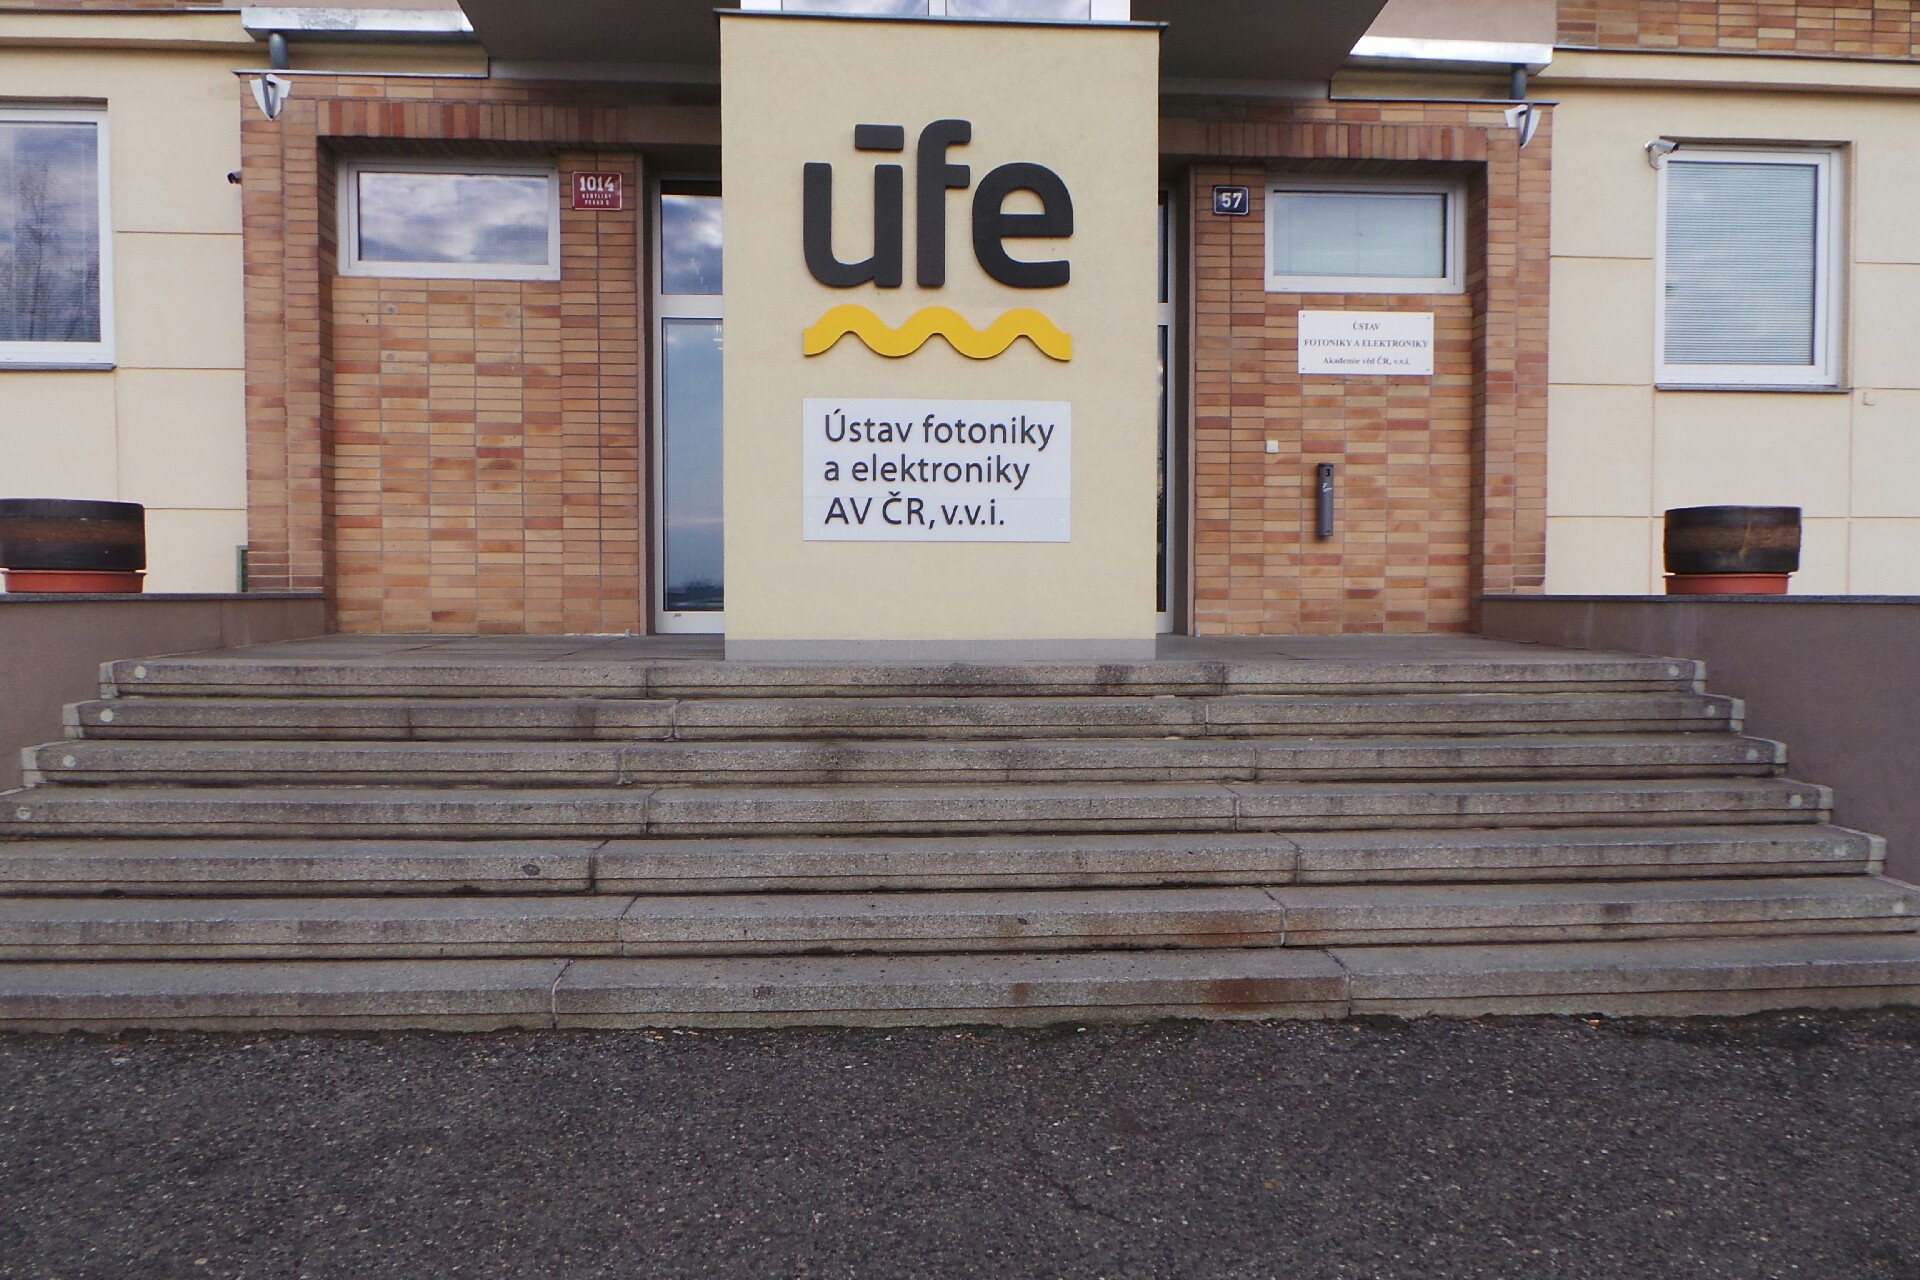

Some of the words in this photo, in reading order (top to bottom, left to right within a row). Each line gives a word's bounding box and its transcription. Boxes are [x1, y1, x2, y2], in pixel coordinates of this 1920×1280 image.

[580, 176, 614, 192] 1014
[1222, 192, 1243, 208] 57
[1352, 321, 1381, 331] ÚSTAV
[1304, 338, 1353, 348] FOTONIKY
[1354, 339, 1361, 348] A
[1362, 339, 1429, 349] ELEKTRONIKY
[1323, 356, 1361, 365] Akademie
[1362, 356, 1375, 365] věd
[824, 408, 914, 443] Ústav
[923, 414, 1055, 452] fotoniky
[824, 459, 840, 482] a
[851, 454, 1031, 490] elektroniky
[824, 497, 873, 526] AV
